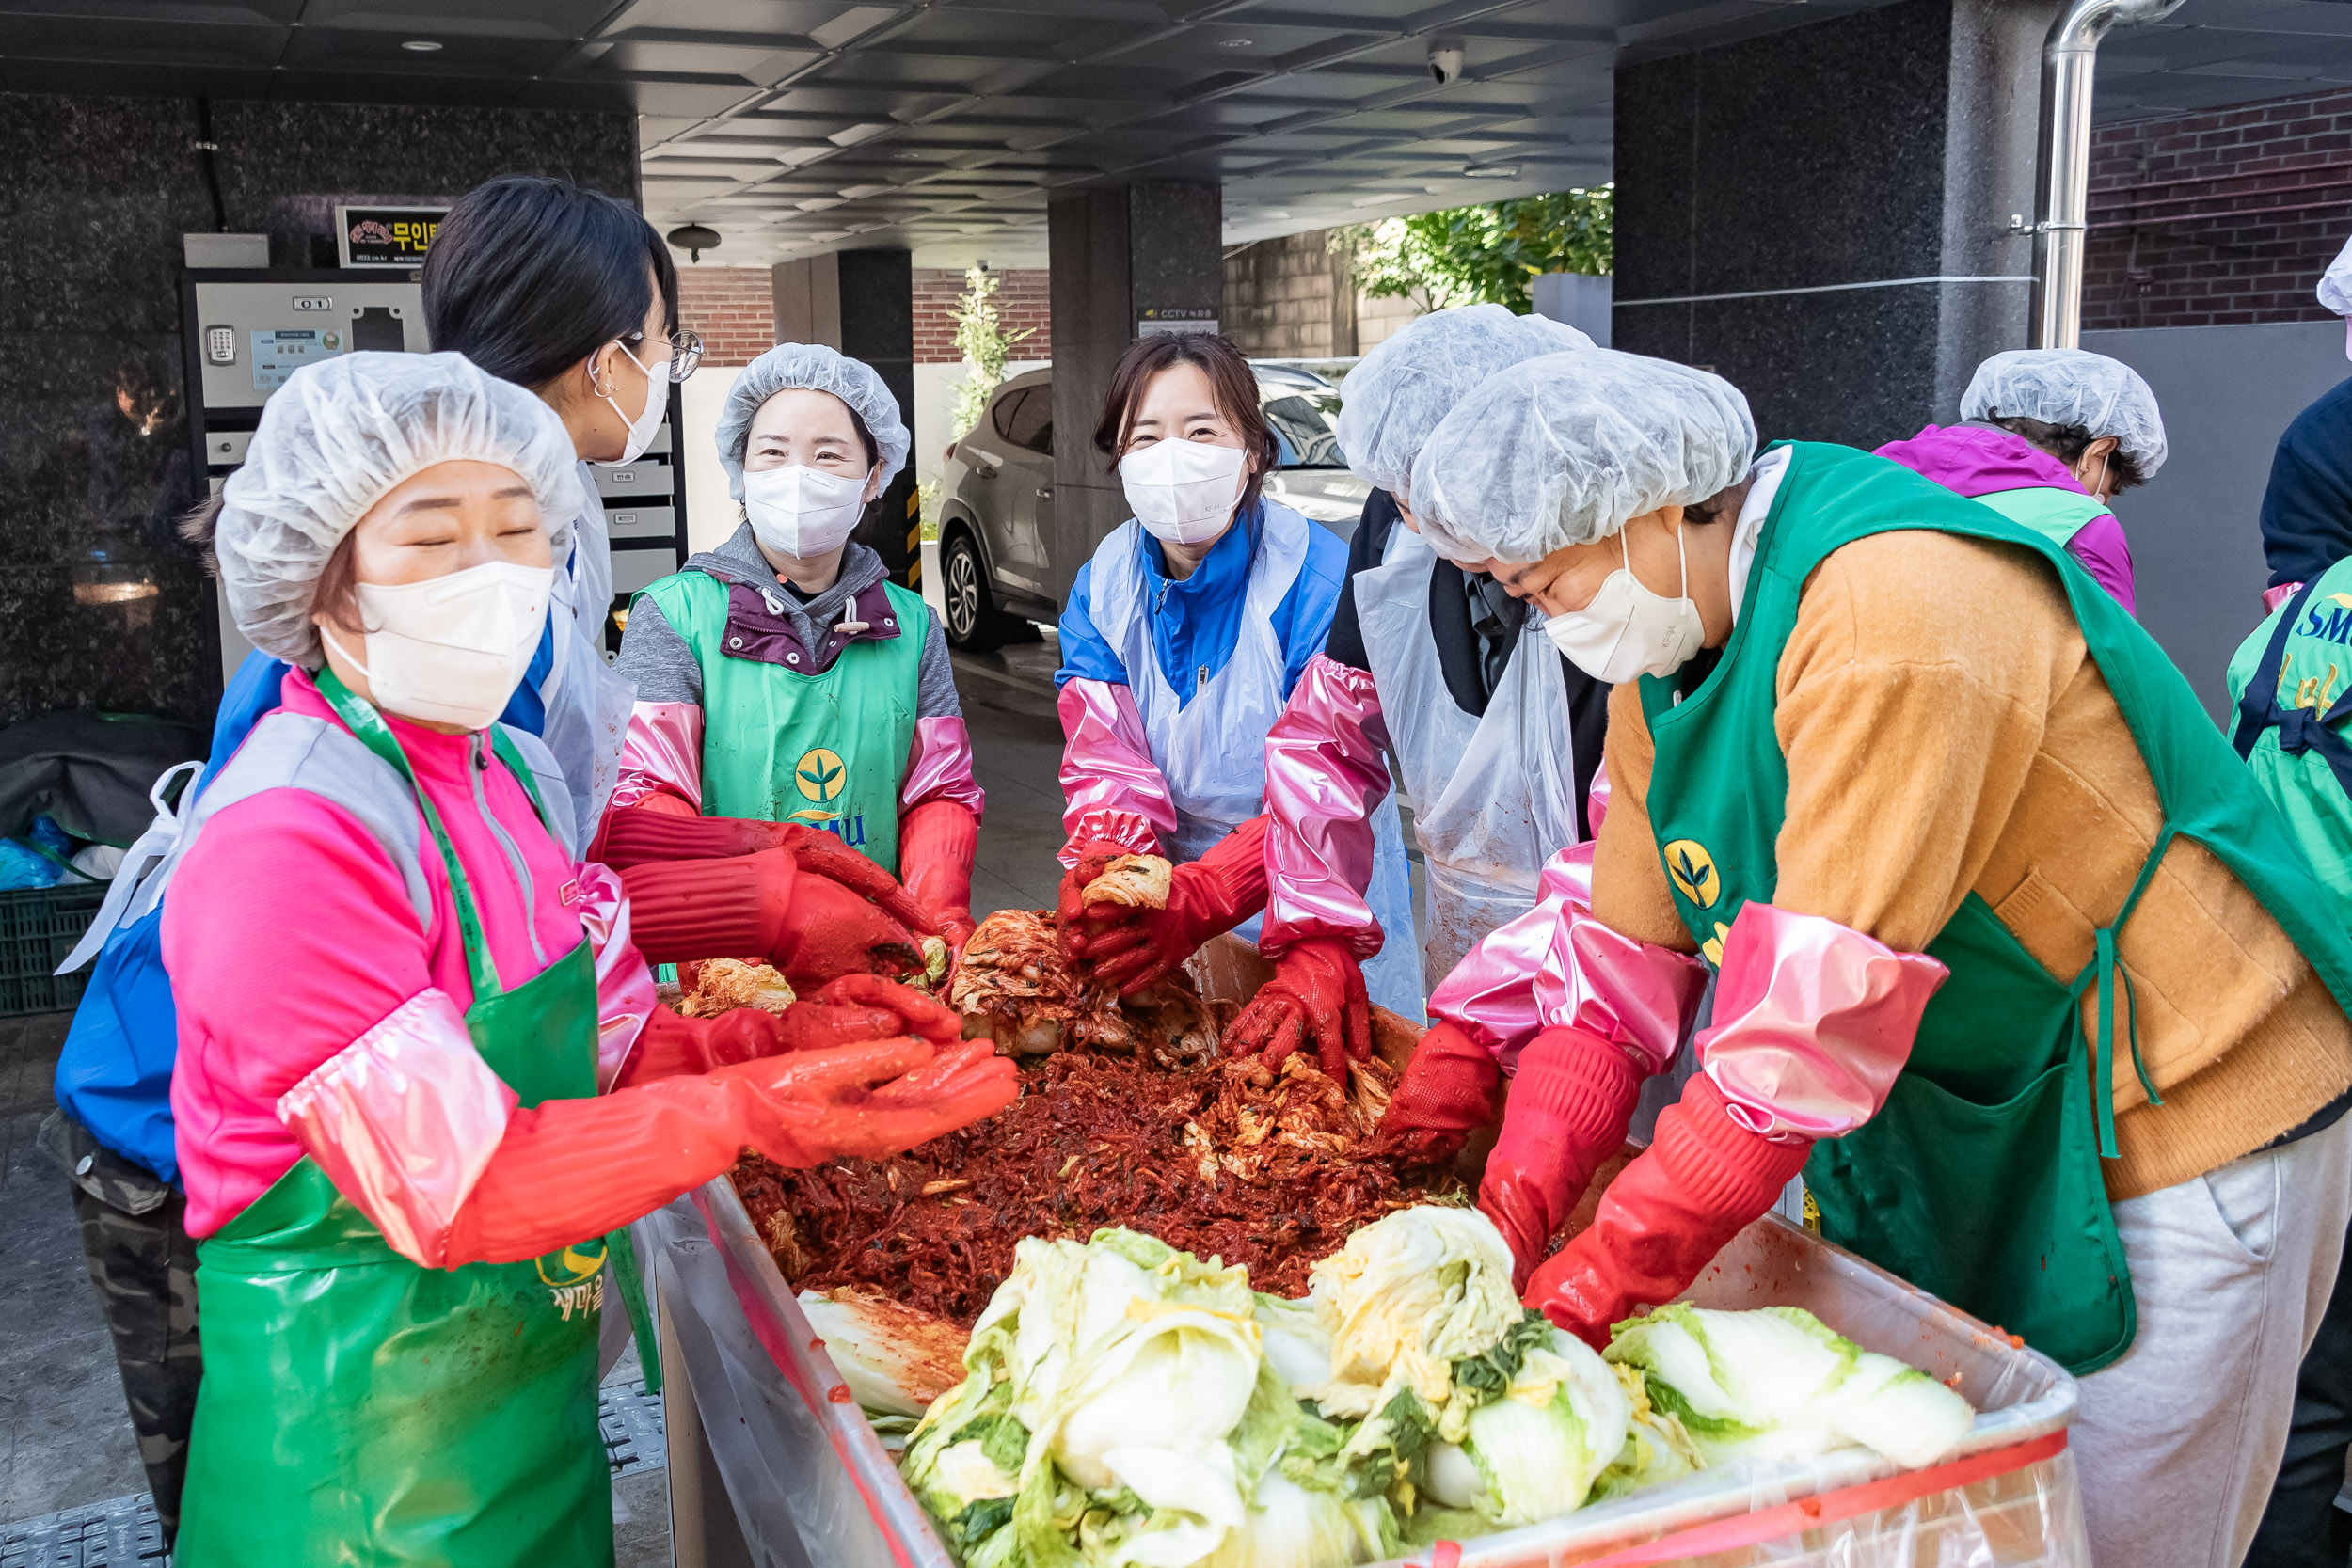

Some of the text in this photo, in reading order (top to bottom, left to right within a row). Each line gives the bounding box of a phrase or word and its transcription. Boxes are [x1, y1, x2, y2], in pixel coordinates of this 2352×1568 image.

[301, 300, 323, 309] 01
[1161, 309, 1187, 319] CCTV
[2296, 600, 2352, 648] SM
[549, 1274, 603, 1322] 새마을
